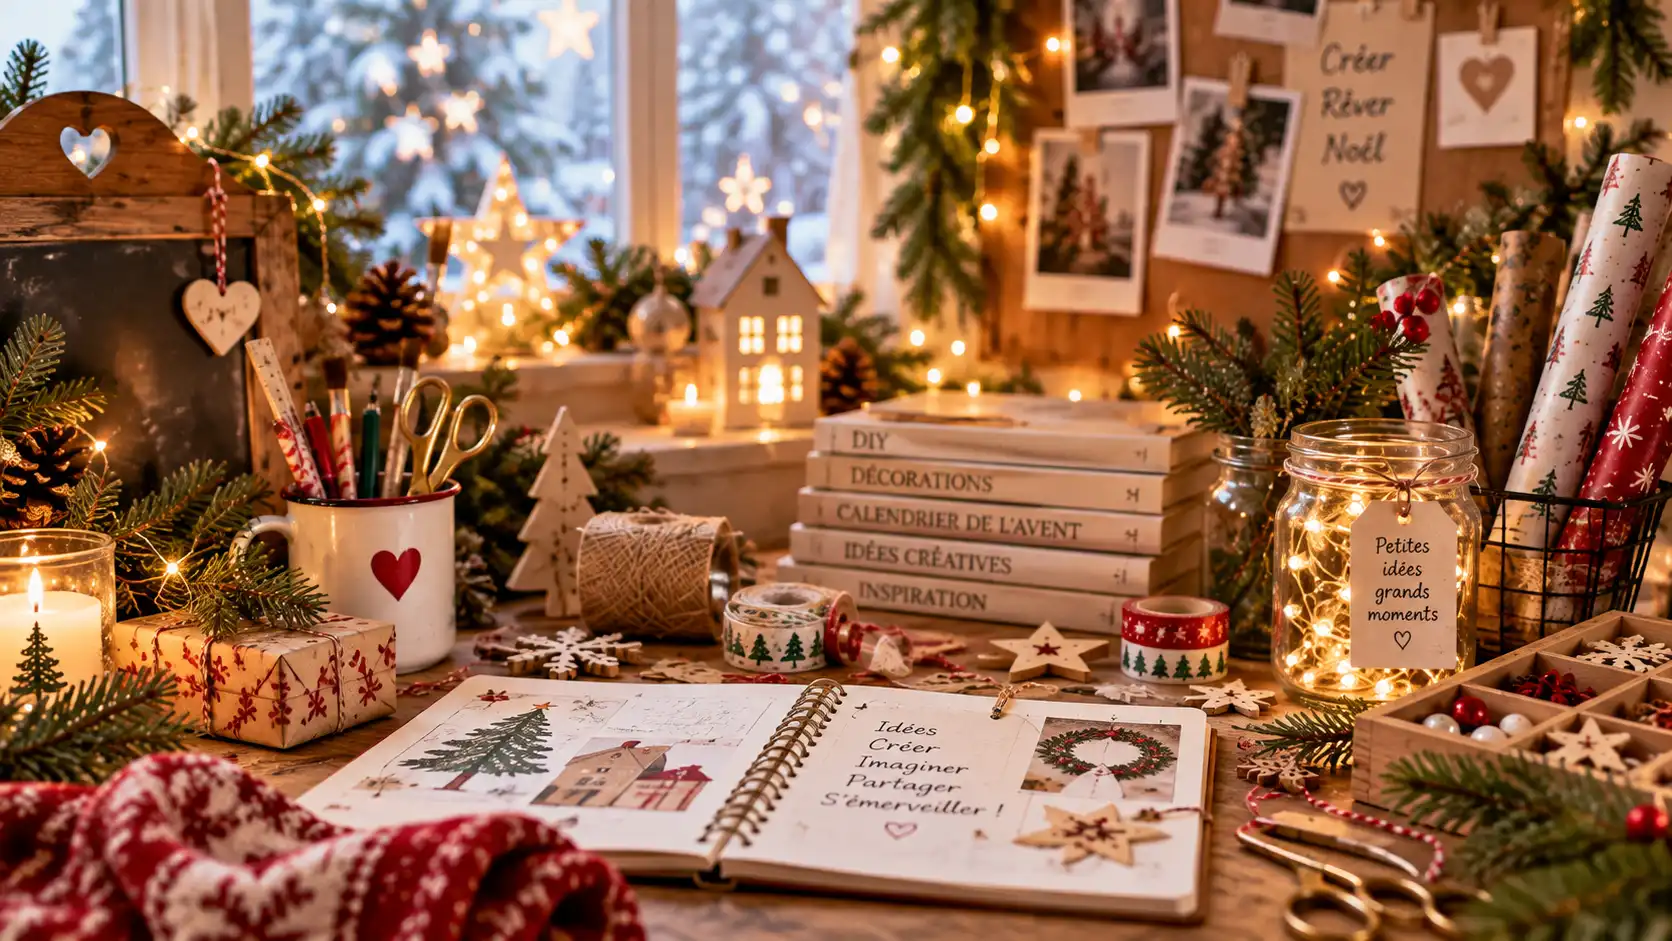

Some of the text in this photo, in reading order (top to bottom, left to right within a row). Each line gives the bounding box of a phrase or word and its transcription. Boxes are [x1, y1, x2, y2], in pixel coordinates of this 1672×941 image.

[852, 430, 888, 450] DIY
[851, 465, 993, 493] DÉCORATIONS
[837, 504, 1082, 541] CALENDRIER DE L'AVENT
[1375, 536, 1430, 554] Petites
[844, 539, 1012, 575] IDÉES CRÉATIVES
[1383, 560, 1422, 576] idées
[859, 581, 988, 611] INSPIRATION
[1375, 582, 1430, 605] grands
[1368, 606, 1438, 621] moments
[875, 721, 938, 736] Idées
[869, 738, 941, 754] Créer
[855, 755, 969, 776] Imaginer
[846, 774, 962, 797] Partager
[821, 792, 986, 816] S'émerveiller
